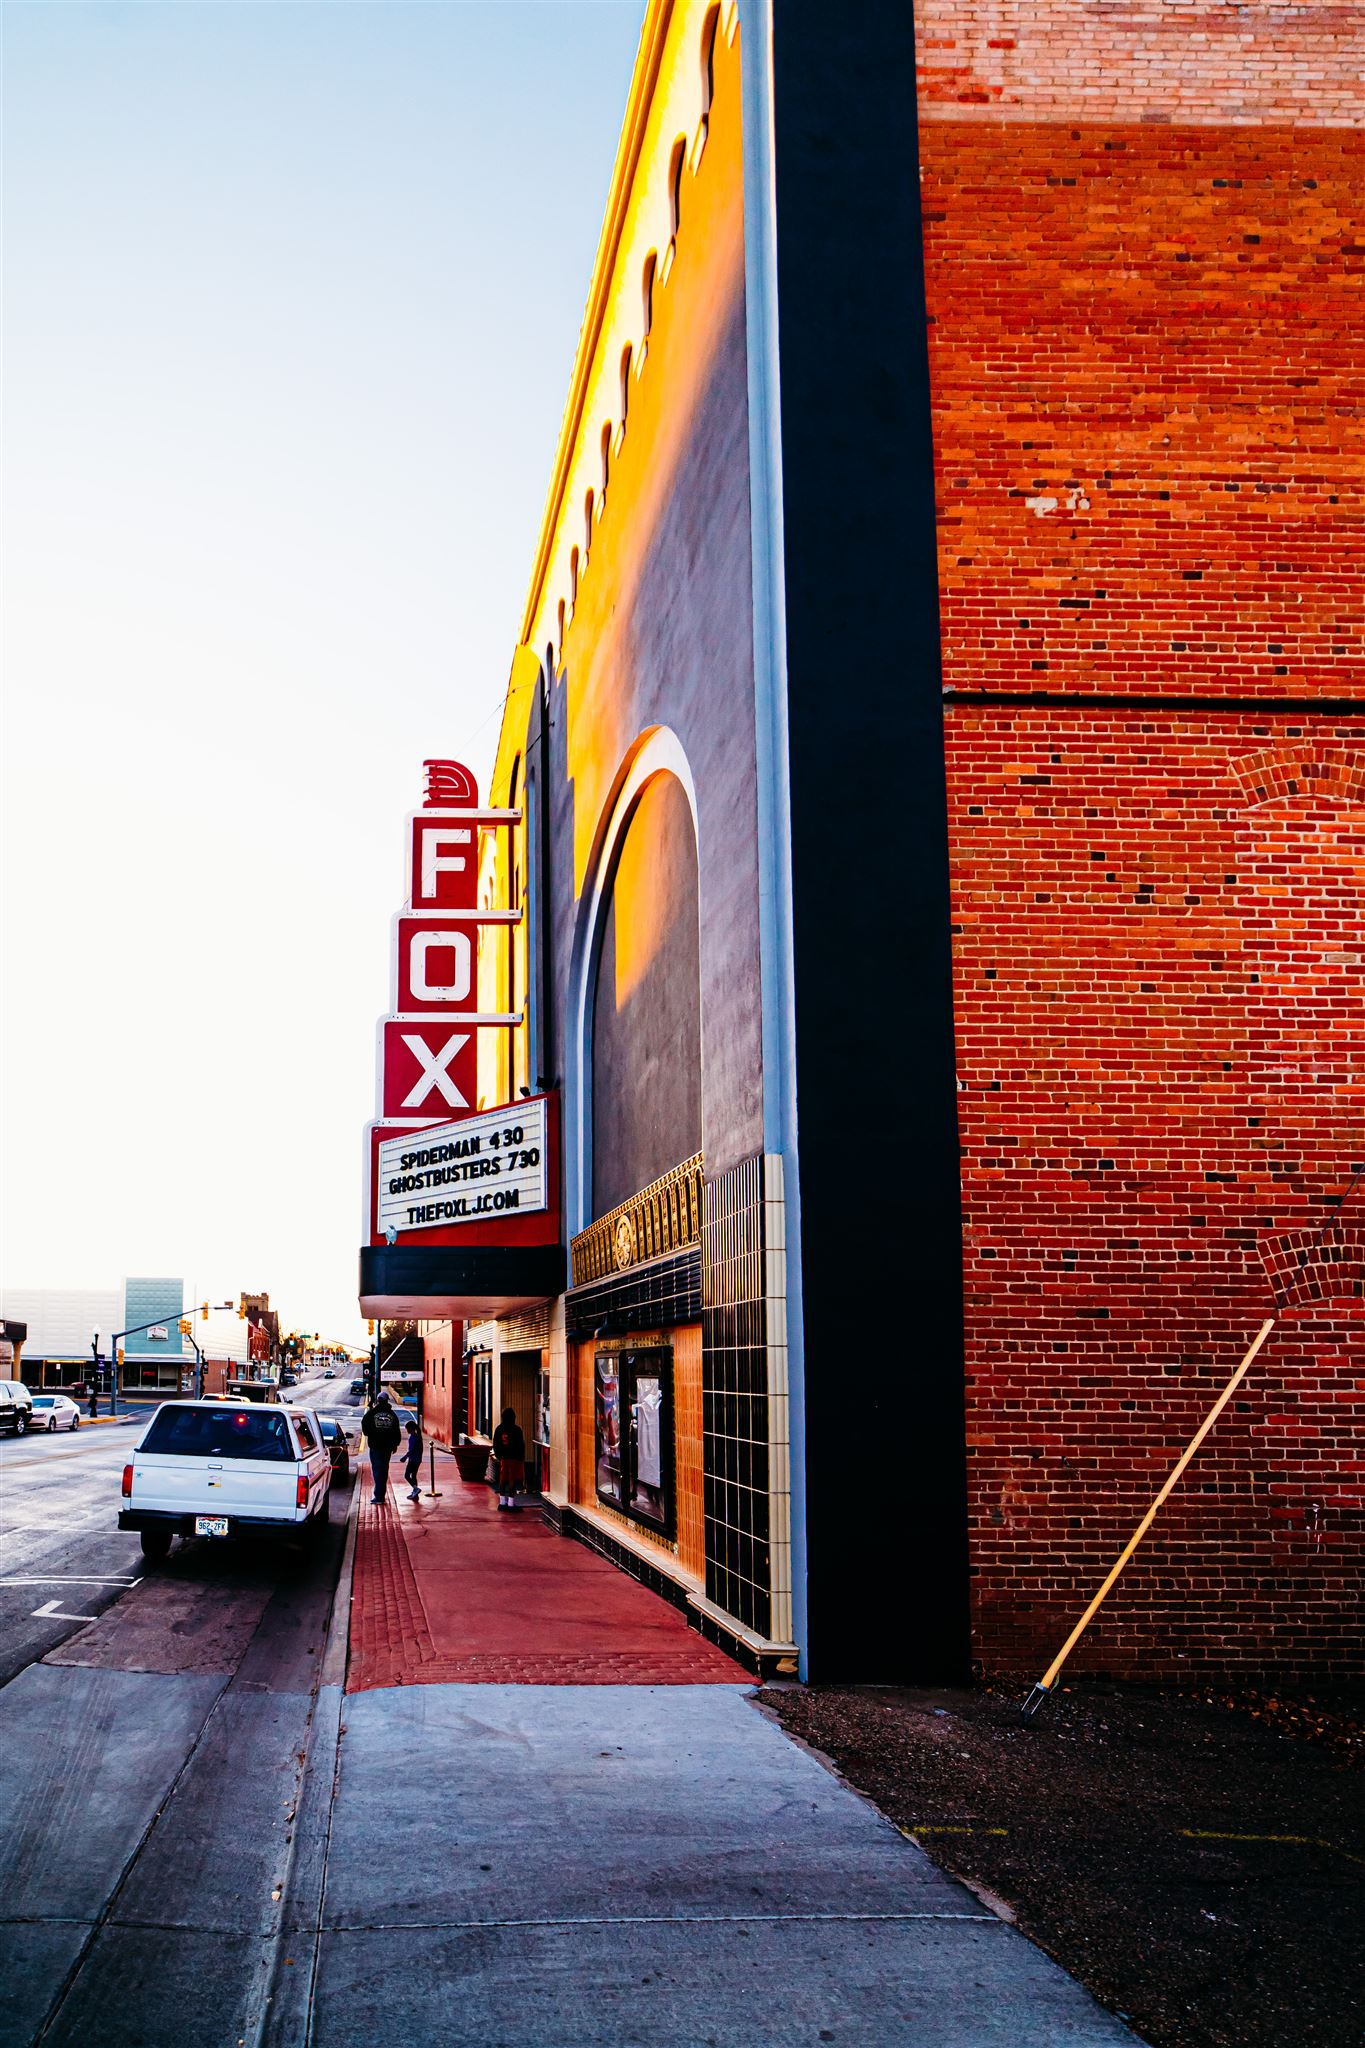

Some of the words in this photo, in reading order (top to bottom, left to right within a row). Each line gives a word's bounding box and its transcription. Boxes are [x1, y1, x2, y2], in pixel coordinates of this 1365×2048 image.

[400, 828, 472, 1108] FOX
[389, 1156, 502, 1194] GHOSTBUSTERS
[507, 1148, 540, 1171] 730
[400, 1136, 480, 1171] SPIDERMAN
